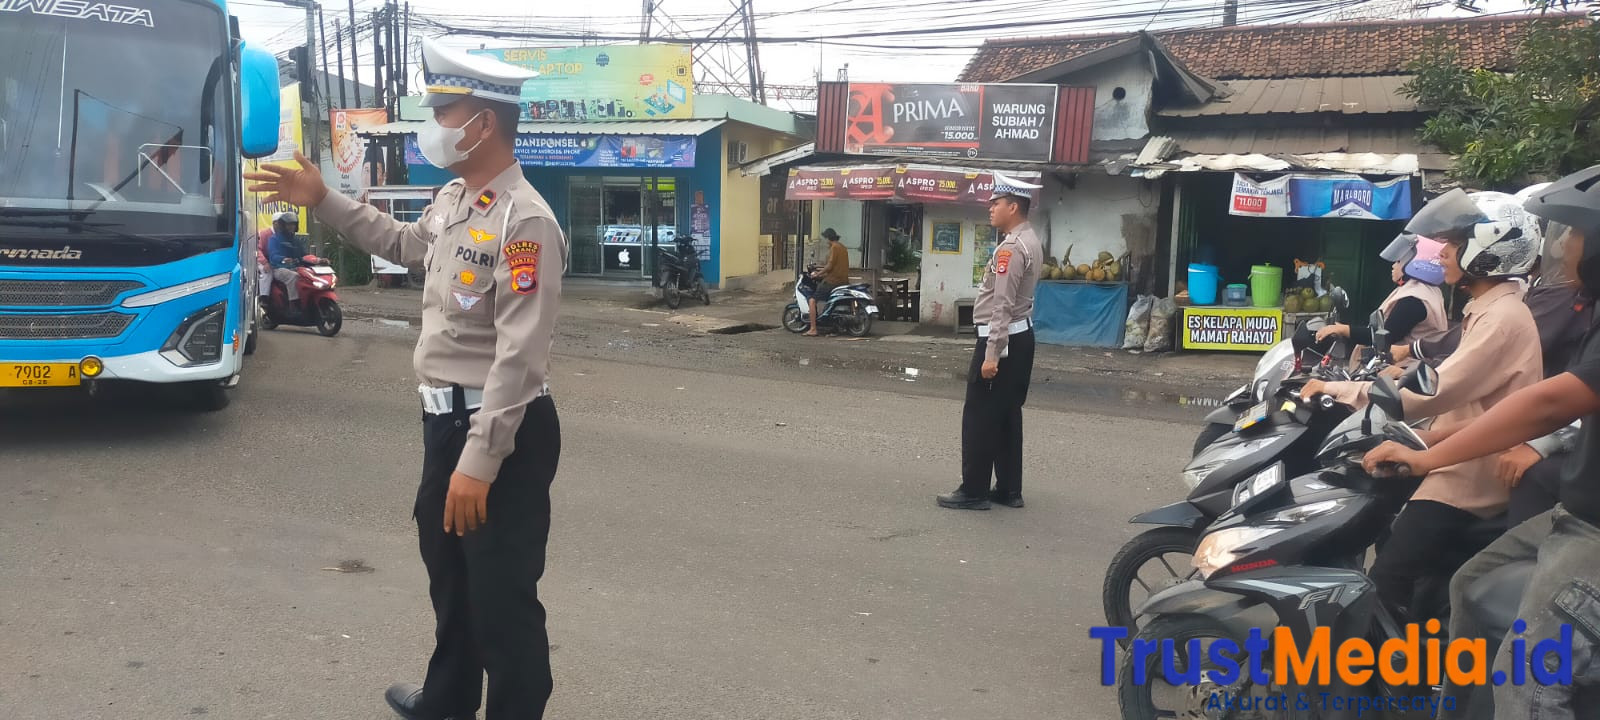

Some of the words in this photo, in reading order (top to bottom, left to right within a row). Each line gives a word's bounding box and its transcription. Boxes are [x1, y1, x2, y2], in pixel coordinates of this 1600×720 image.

[503, 49, 547, 62] SERVIS
[893, 97, 965, 124] PRIMA
[992, 103, 1046, 115] WARUNG
[991, 115, 1037, 127] SUBIAH
[1038, 116, 1045, 128] /
[994, 128, 1039, 140] AHMAD
[795, 178, 819, 186] ASPRO
[849, 176, 874, 185] ASPRO
[905, 177, 936, 186] ASPRO
[976, 182, 994, 191] ASP
[1333, 189, 1371, 206] MARLBORO
[505, 241, 538, 254] POLRES
[455, 245, 495, 268] POLRI
[1187, 315, 1202, 328] ES
[1203, 316, 1243, 329] KELAPA
[1245, 317, 1277, 330] MUDA
[1190, 329, 1229, 343] MAMAT
[1230, 330, 1273, 344] RAHAYU
[14, 365, 51, 379] 7902
[69, 365, 76, 378] A
[1231, 558, 1278, 574] HONDA
